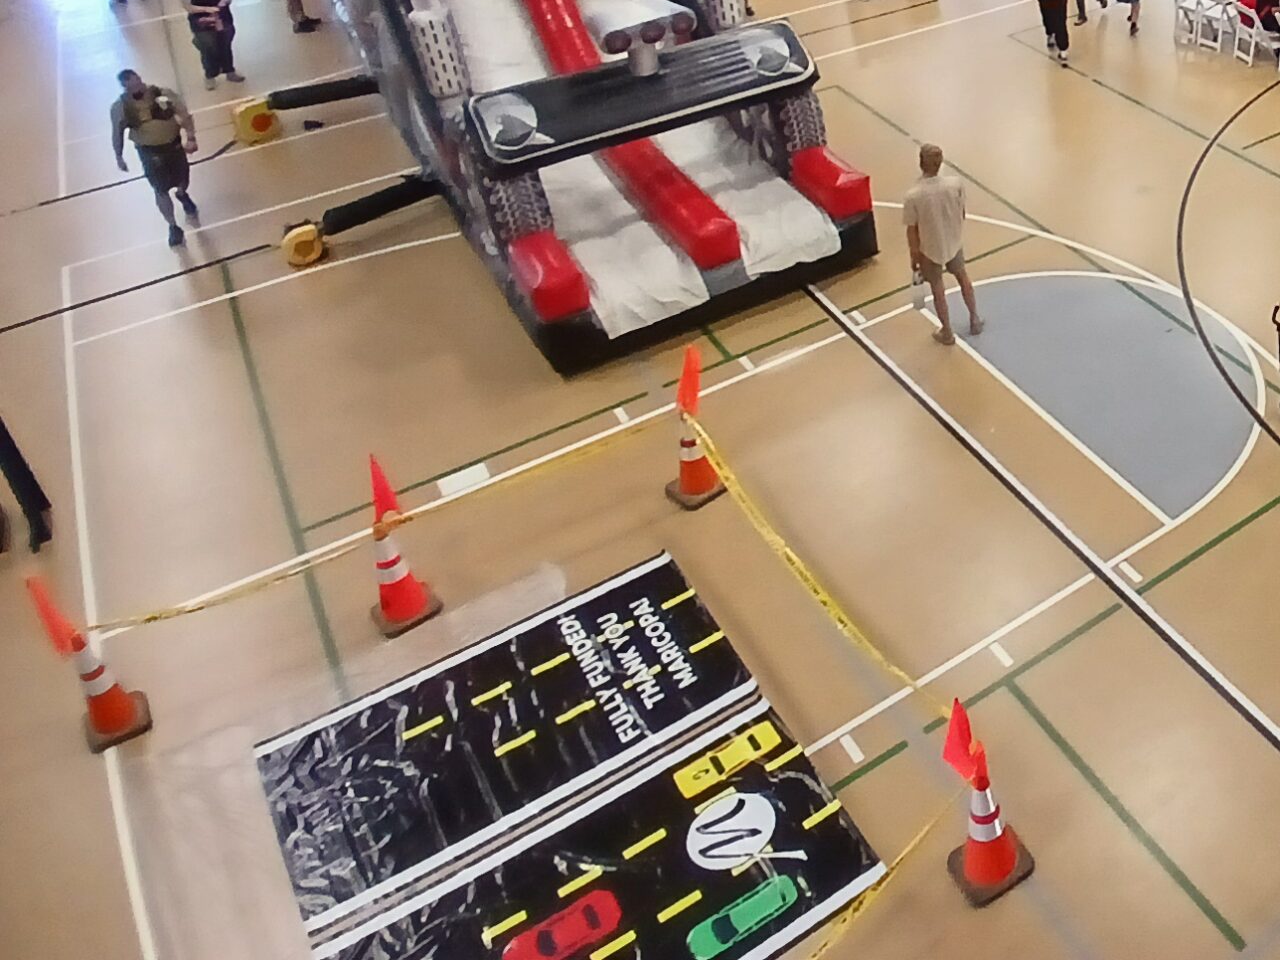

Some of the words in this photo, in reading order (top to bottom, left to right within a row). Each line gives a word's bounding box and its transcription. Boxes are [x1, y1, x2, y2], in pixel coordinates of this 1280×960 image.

[557, 614, 611, 688] FUNDED!
[596, 612, 630, 651] YOU
[629, 597, 698, 689] MARICOPA!
[616, 645, 665, 710] THANK
[595, 687, 642, 744] FULLY
